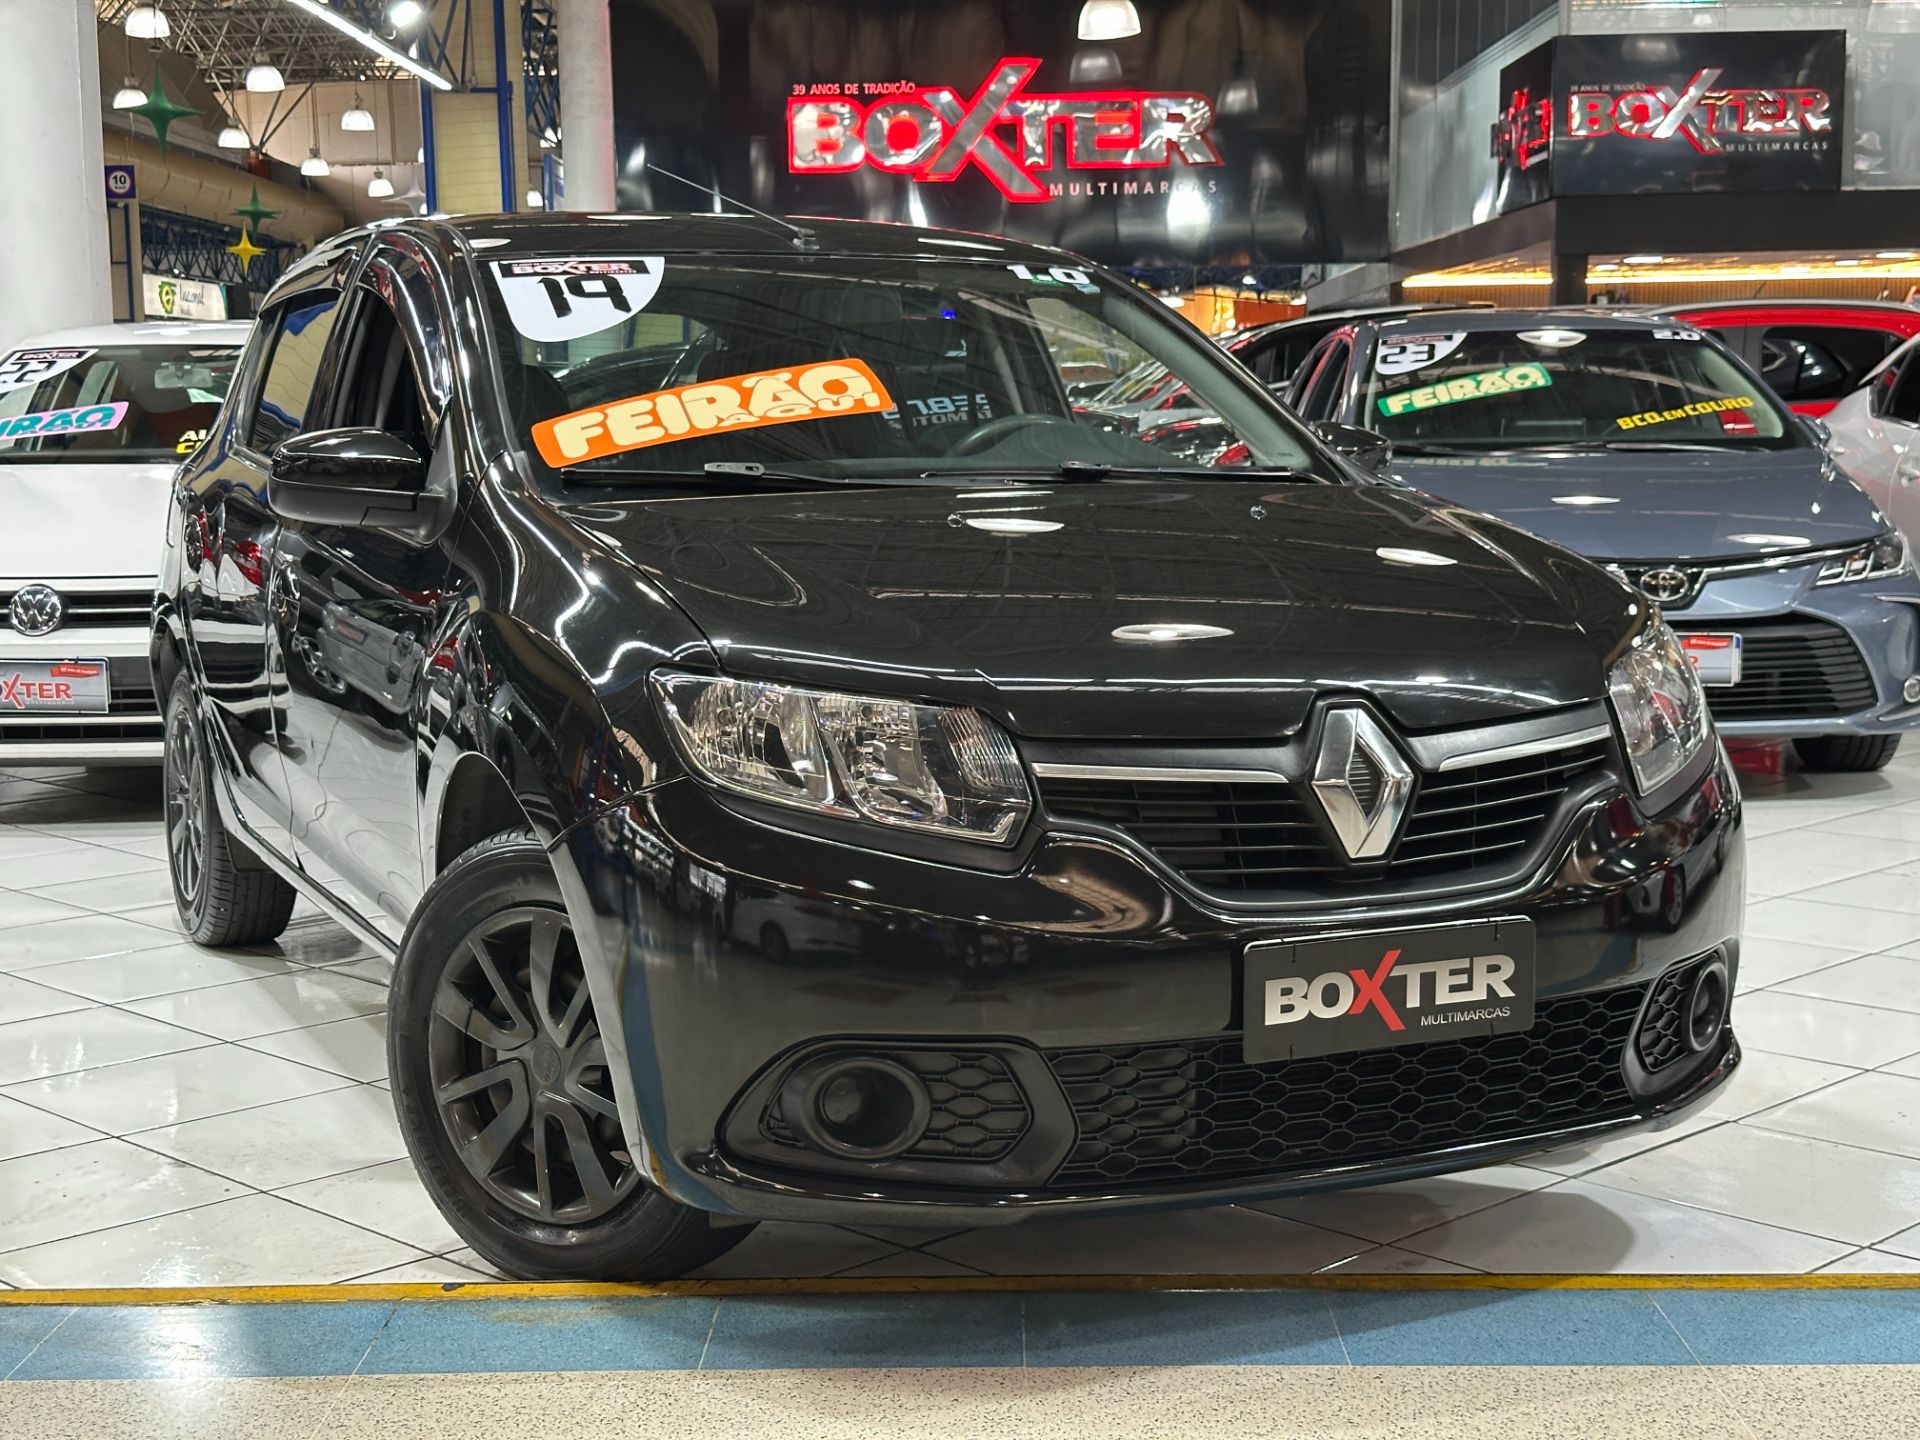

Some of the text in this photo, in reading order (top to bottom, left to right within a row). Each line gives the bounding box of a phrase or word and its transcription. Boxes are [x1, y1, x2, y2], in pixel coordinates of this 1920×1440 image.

[792, 80, 916, 95] 39 ANOS DE TRADIÇÃO
[1567, 67, 1833, 153] BOXTER
[788, 57, 1223, 202] BOXTER
[1725, 141, 1829, 152] MULTIMARCAS
[112, 174, 127, 185] 10
[1049, 180, 1218, 197] MULTIMARCAS
[512, 261, 634, 275] BOXTER
[1006, 264, 1091, 284] 1.0
[536, 274, 632, 318] 19
[1651, 328, 1701, 341] 2.0
[1380, 343, 1436, 364] 23
[1386, 366, 1543, 414] FEIRÃO
[552, 365, 873, 458] FEIRÃO
[1662, 409, 1686, 421] EM
[1683, 396, 1754, 417] COURO
[1264, 949, 1516, 1031] BOXTER
[1420, 1006, 1511, 1027] MULTIMARCAS
